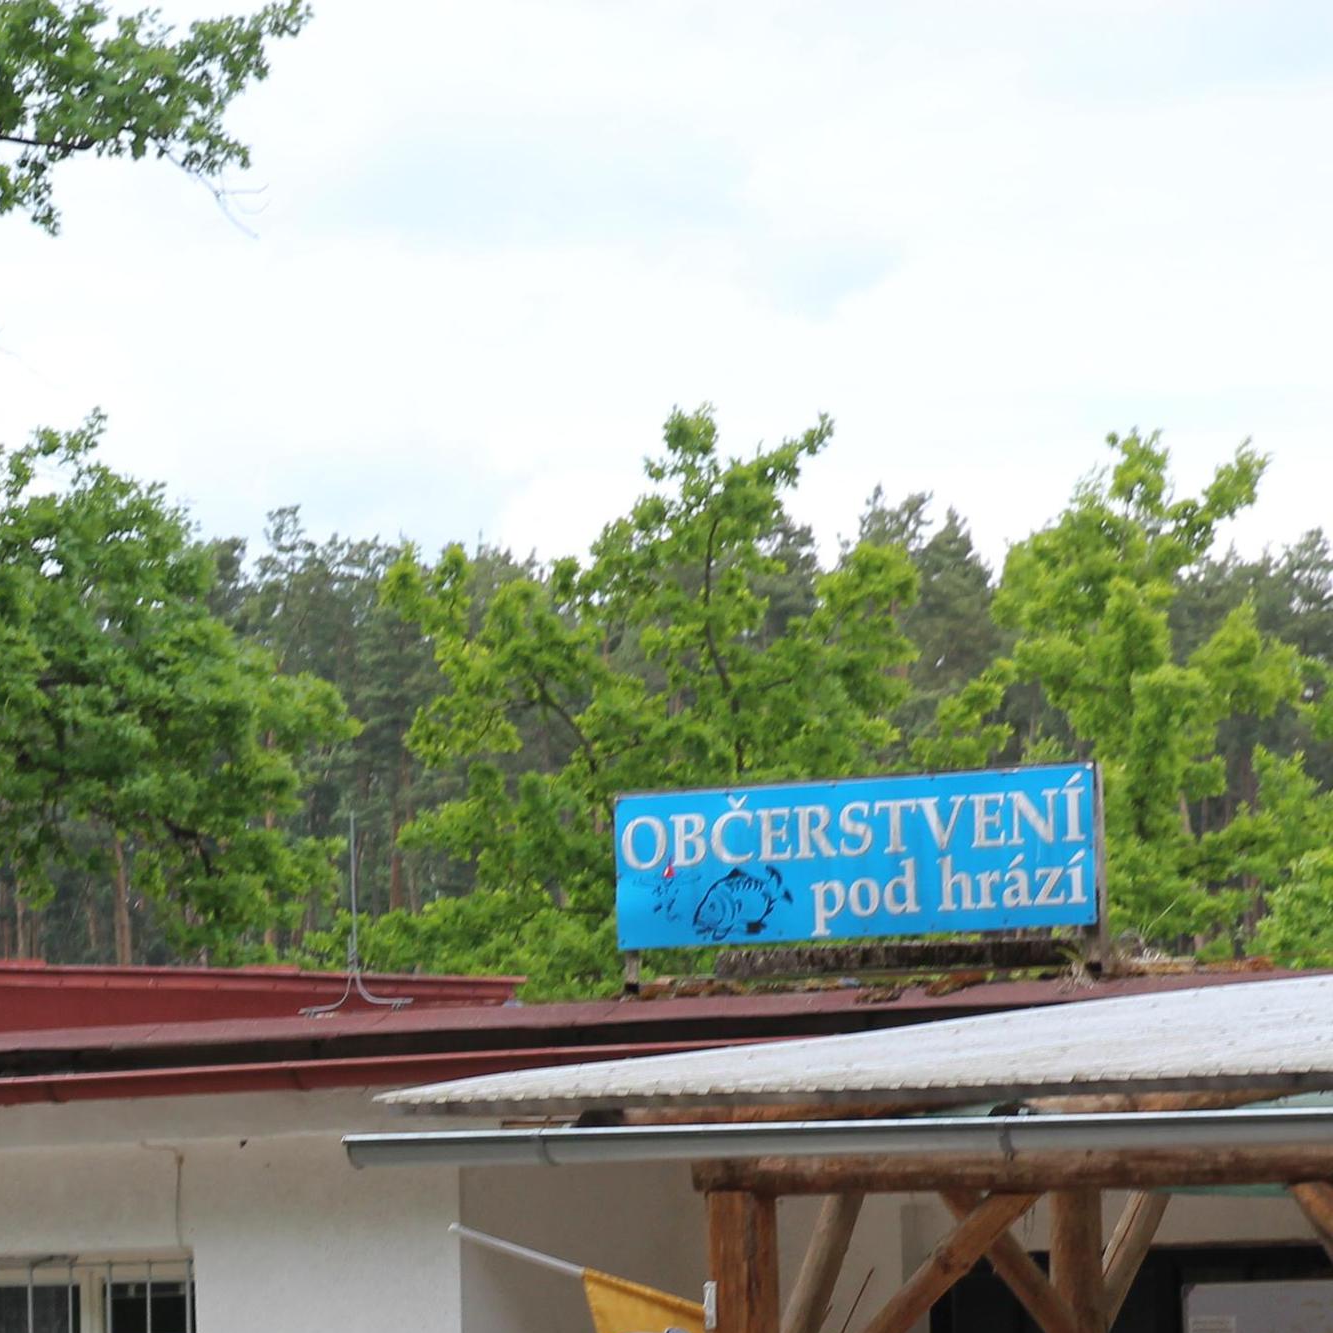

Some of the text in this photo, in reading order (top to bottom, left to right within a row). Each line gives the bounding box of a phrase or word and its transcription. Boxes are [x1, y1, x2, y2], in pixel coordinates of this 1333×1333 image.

[621, 771, 1086, 871] OBČERSTVENÍ
[810, 849, 1087, 938] pod hrází
